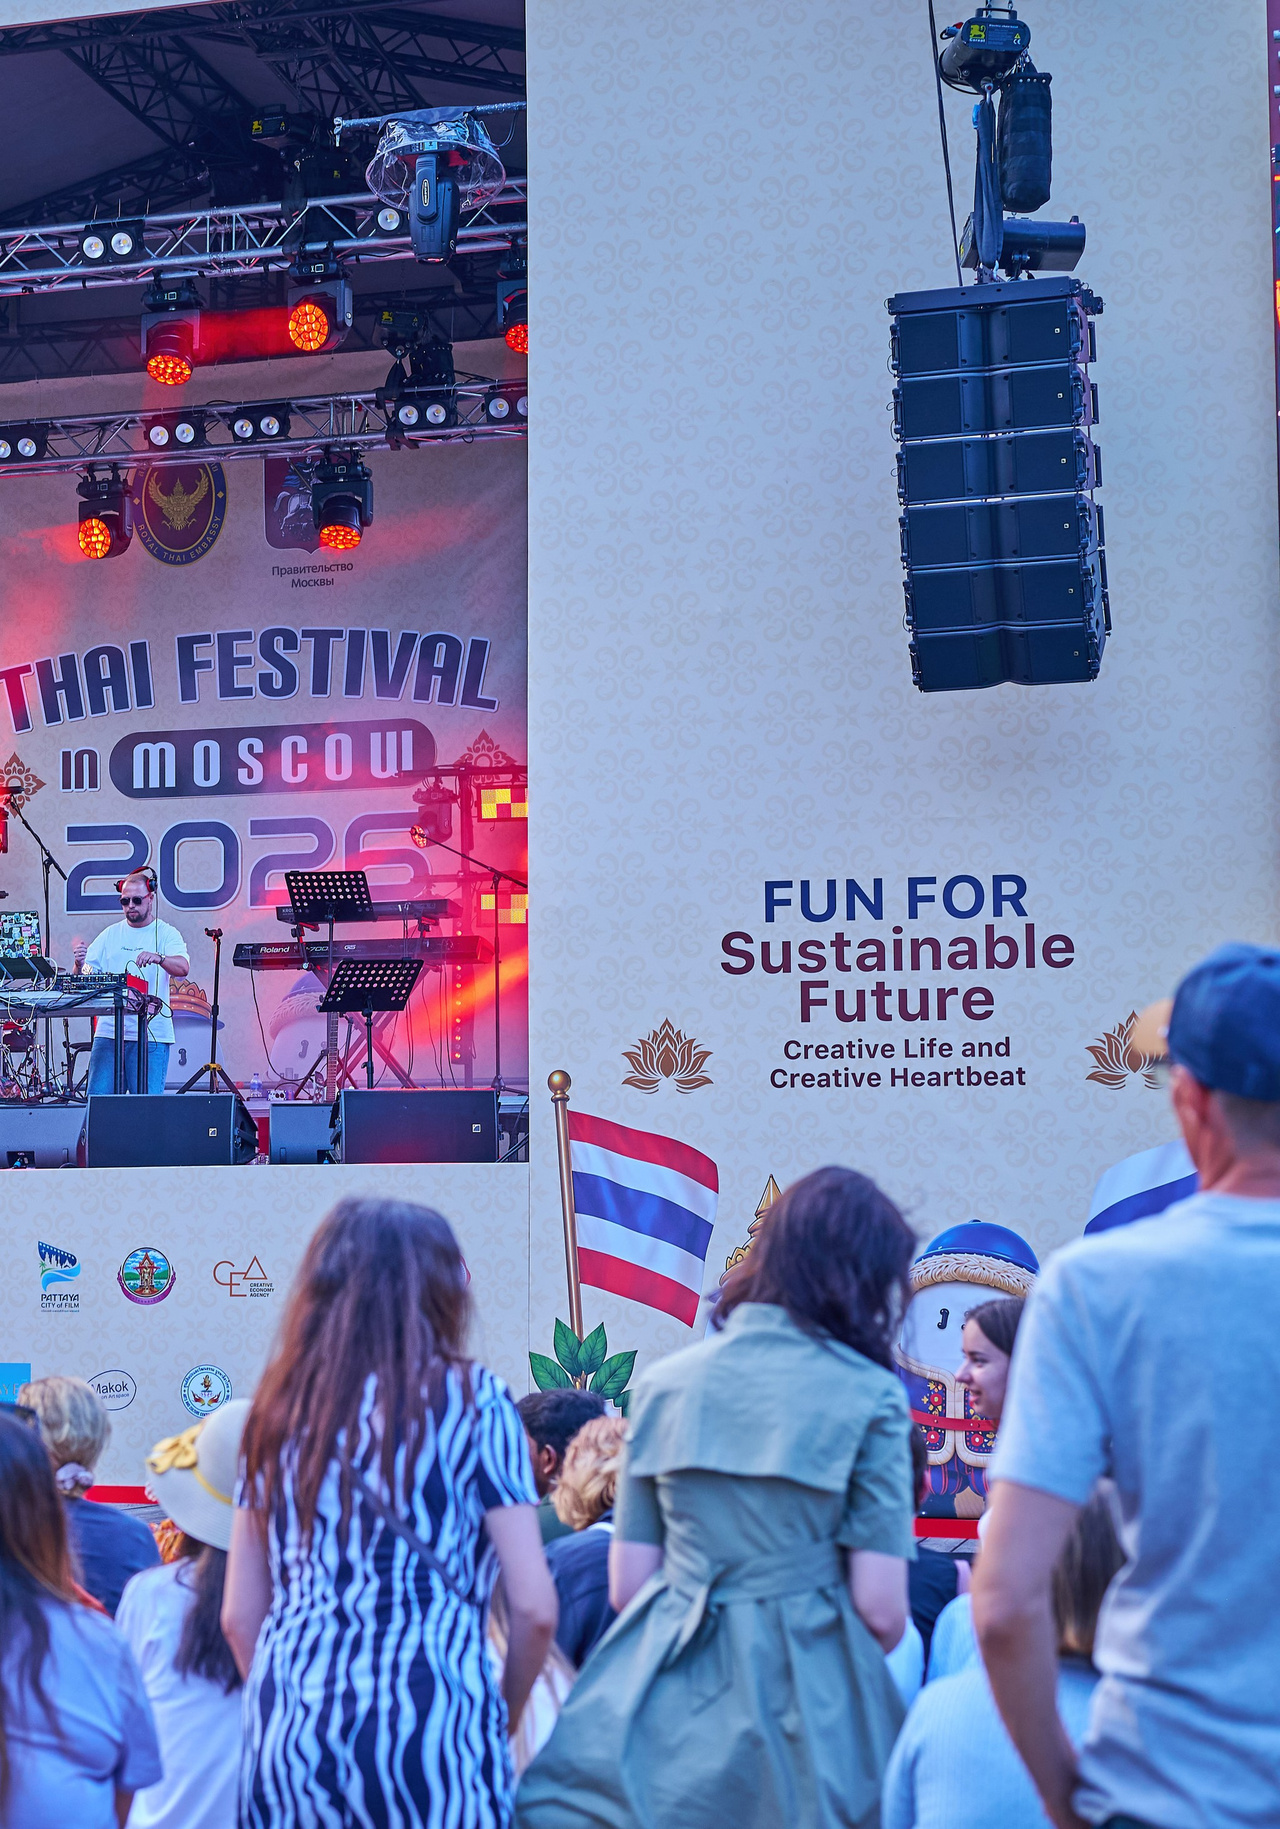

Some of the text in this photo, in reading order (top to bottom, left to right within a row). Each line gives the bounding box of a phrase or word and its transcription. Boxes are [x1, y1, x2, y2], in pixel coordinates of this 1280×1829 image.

[138, 515, 221, 563] ROYAL THAI EMBASSY
[272, 561, 353, 577] Правительство
[291, 577, 334, 588] Москвы
[176, 627, 499, 712] FESTIVAL
[763, 873, 1029, 923] FUN FOR
[260, 946, 290, 954] Roland
[720, 922, 1075, 976] Sustainable
[799, 979, 996, 1023] Future
[782, 1036, 1011, 1061] Creative Life and
[769, 1065, 1026, 1089] Creative Heartbeat
[41, 1294, 79, 1302] PATTAYA
